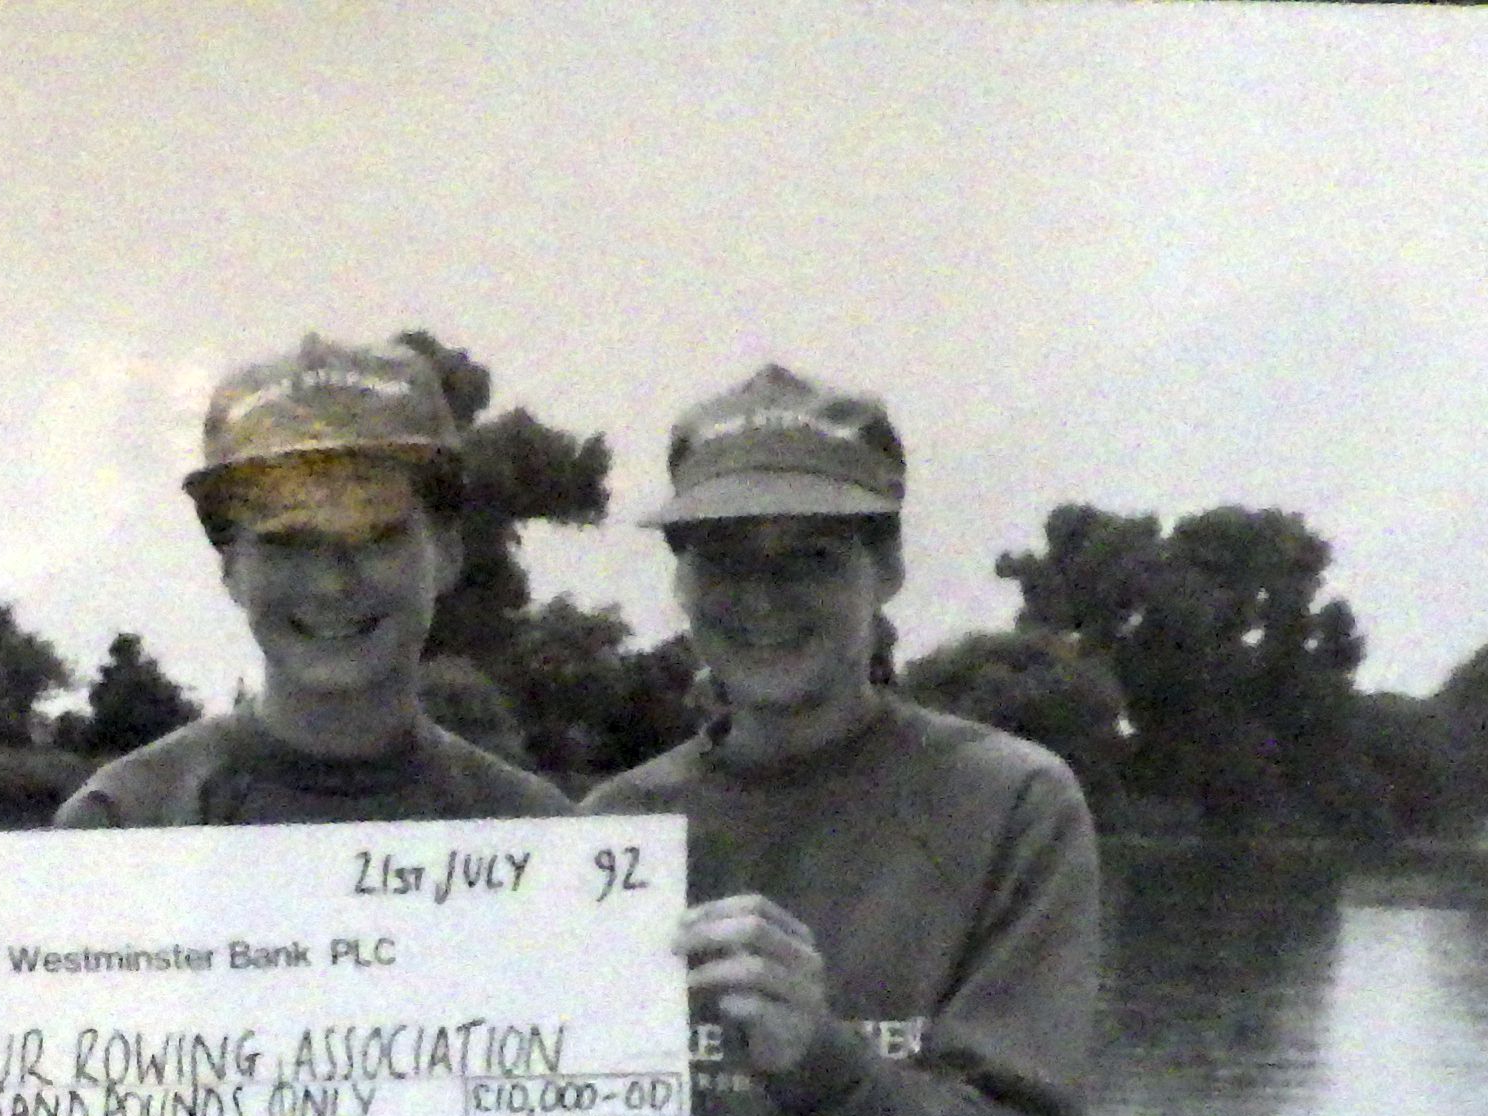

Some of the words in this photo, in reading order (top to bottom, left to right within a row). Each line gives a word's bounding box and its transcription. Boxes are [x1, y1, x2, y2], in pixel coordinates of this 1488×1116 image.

[434, 850, 531, 904] JULY
[594, 846, 649, 902] 92
[8, 944, 213, 974] Westminster
[228, 938, 312, 970] Bank
[330, 937, 397, 967] PLC
[75, 1028, 262, 1088] ROWING
[294, 1017, 564, 1082] ASSOCIATION
